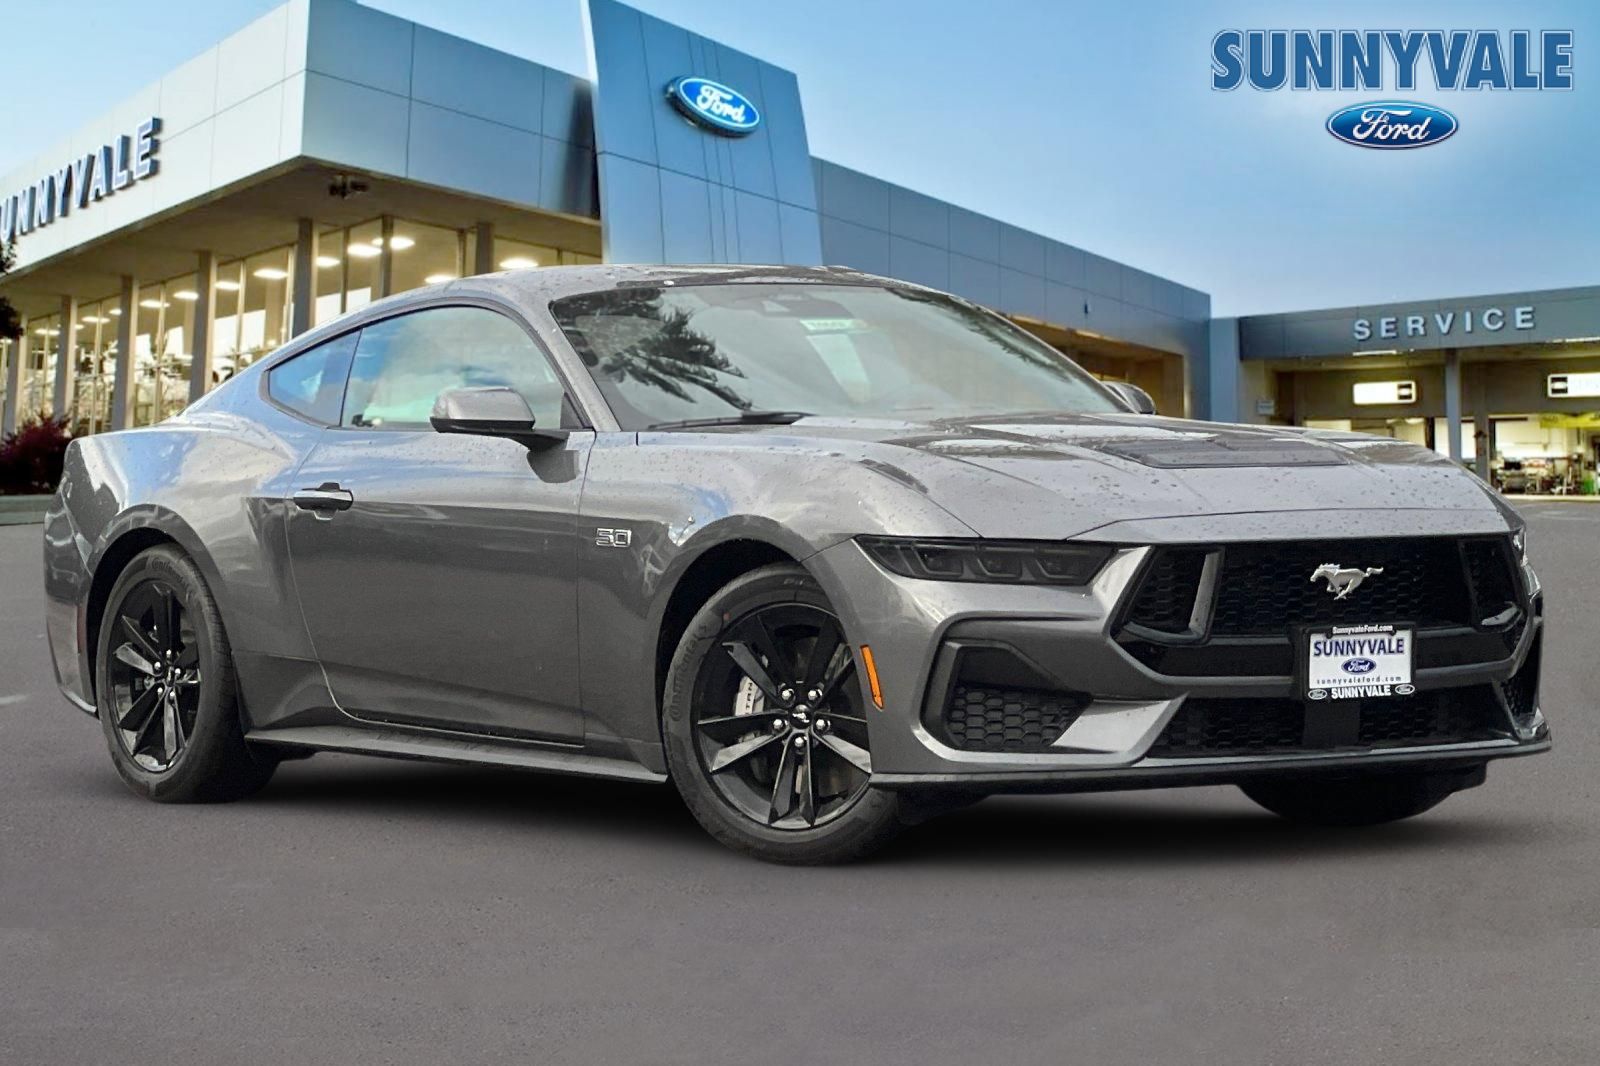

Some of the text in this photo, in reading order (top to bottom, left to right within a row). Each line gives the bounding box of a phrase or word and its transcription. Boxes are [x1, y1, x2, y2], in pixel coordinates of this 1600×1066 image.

[697, 85, 745, 122] Ford
[0, 117, 162, 244] UNNYVALE
[1353, 306, 1535, 340] SERVICE
[1332, 624, 1393, 635] SunnyvaleFord.com
[1313, 638, 1405, 657] SUNNYVALE
[1347, 660, 1371, 672] Ford
[1316, 675, 1402, 685] sunnyvaleford.com
[1331, 685, 1392, 700] SUNNYVALE
